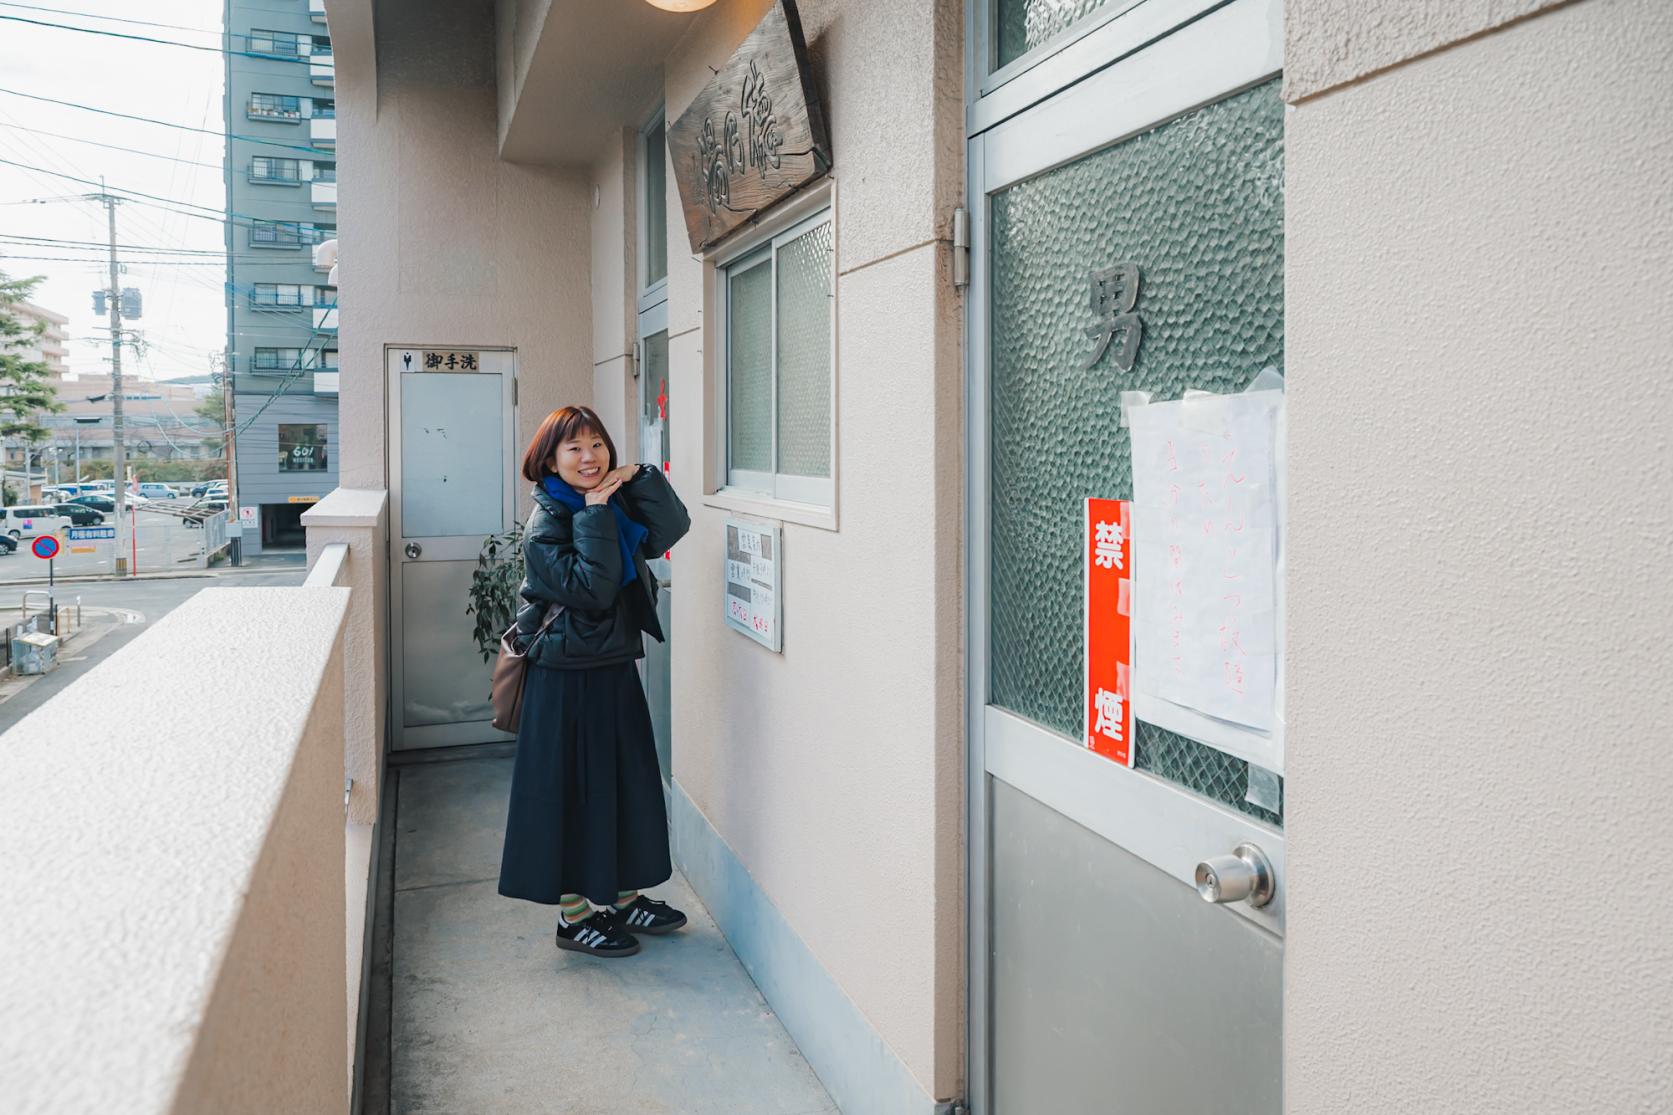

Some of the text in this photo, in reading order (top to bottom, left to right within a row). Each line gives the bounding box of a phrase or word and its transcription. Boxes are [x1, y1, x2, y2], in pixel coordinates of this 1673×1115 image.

[425, 353, 477, 370] 御手洗
[1081, 263, 1142, 372] 男
[1094, 520, 1124, 742] 禁煙
